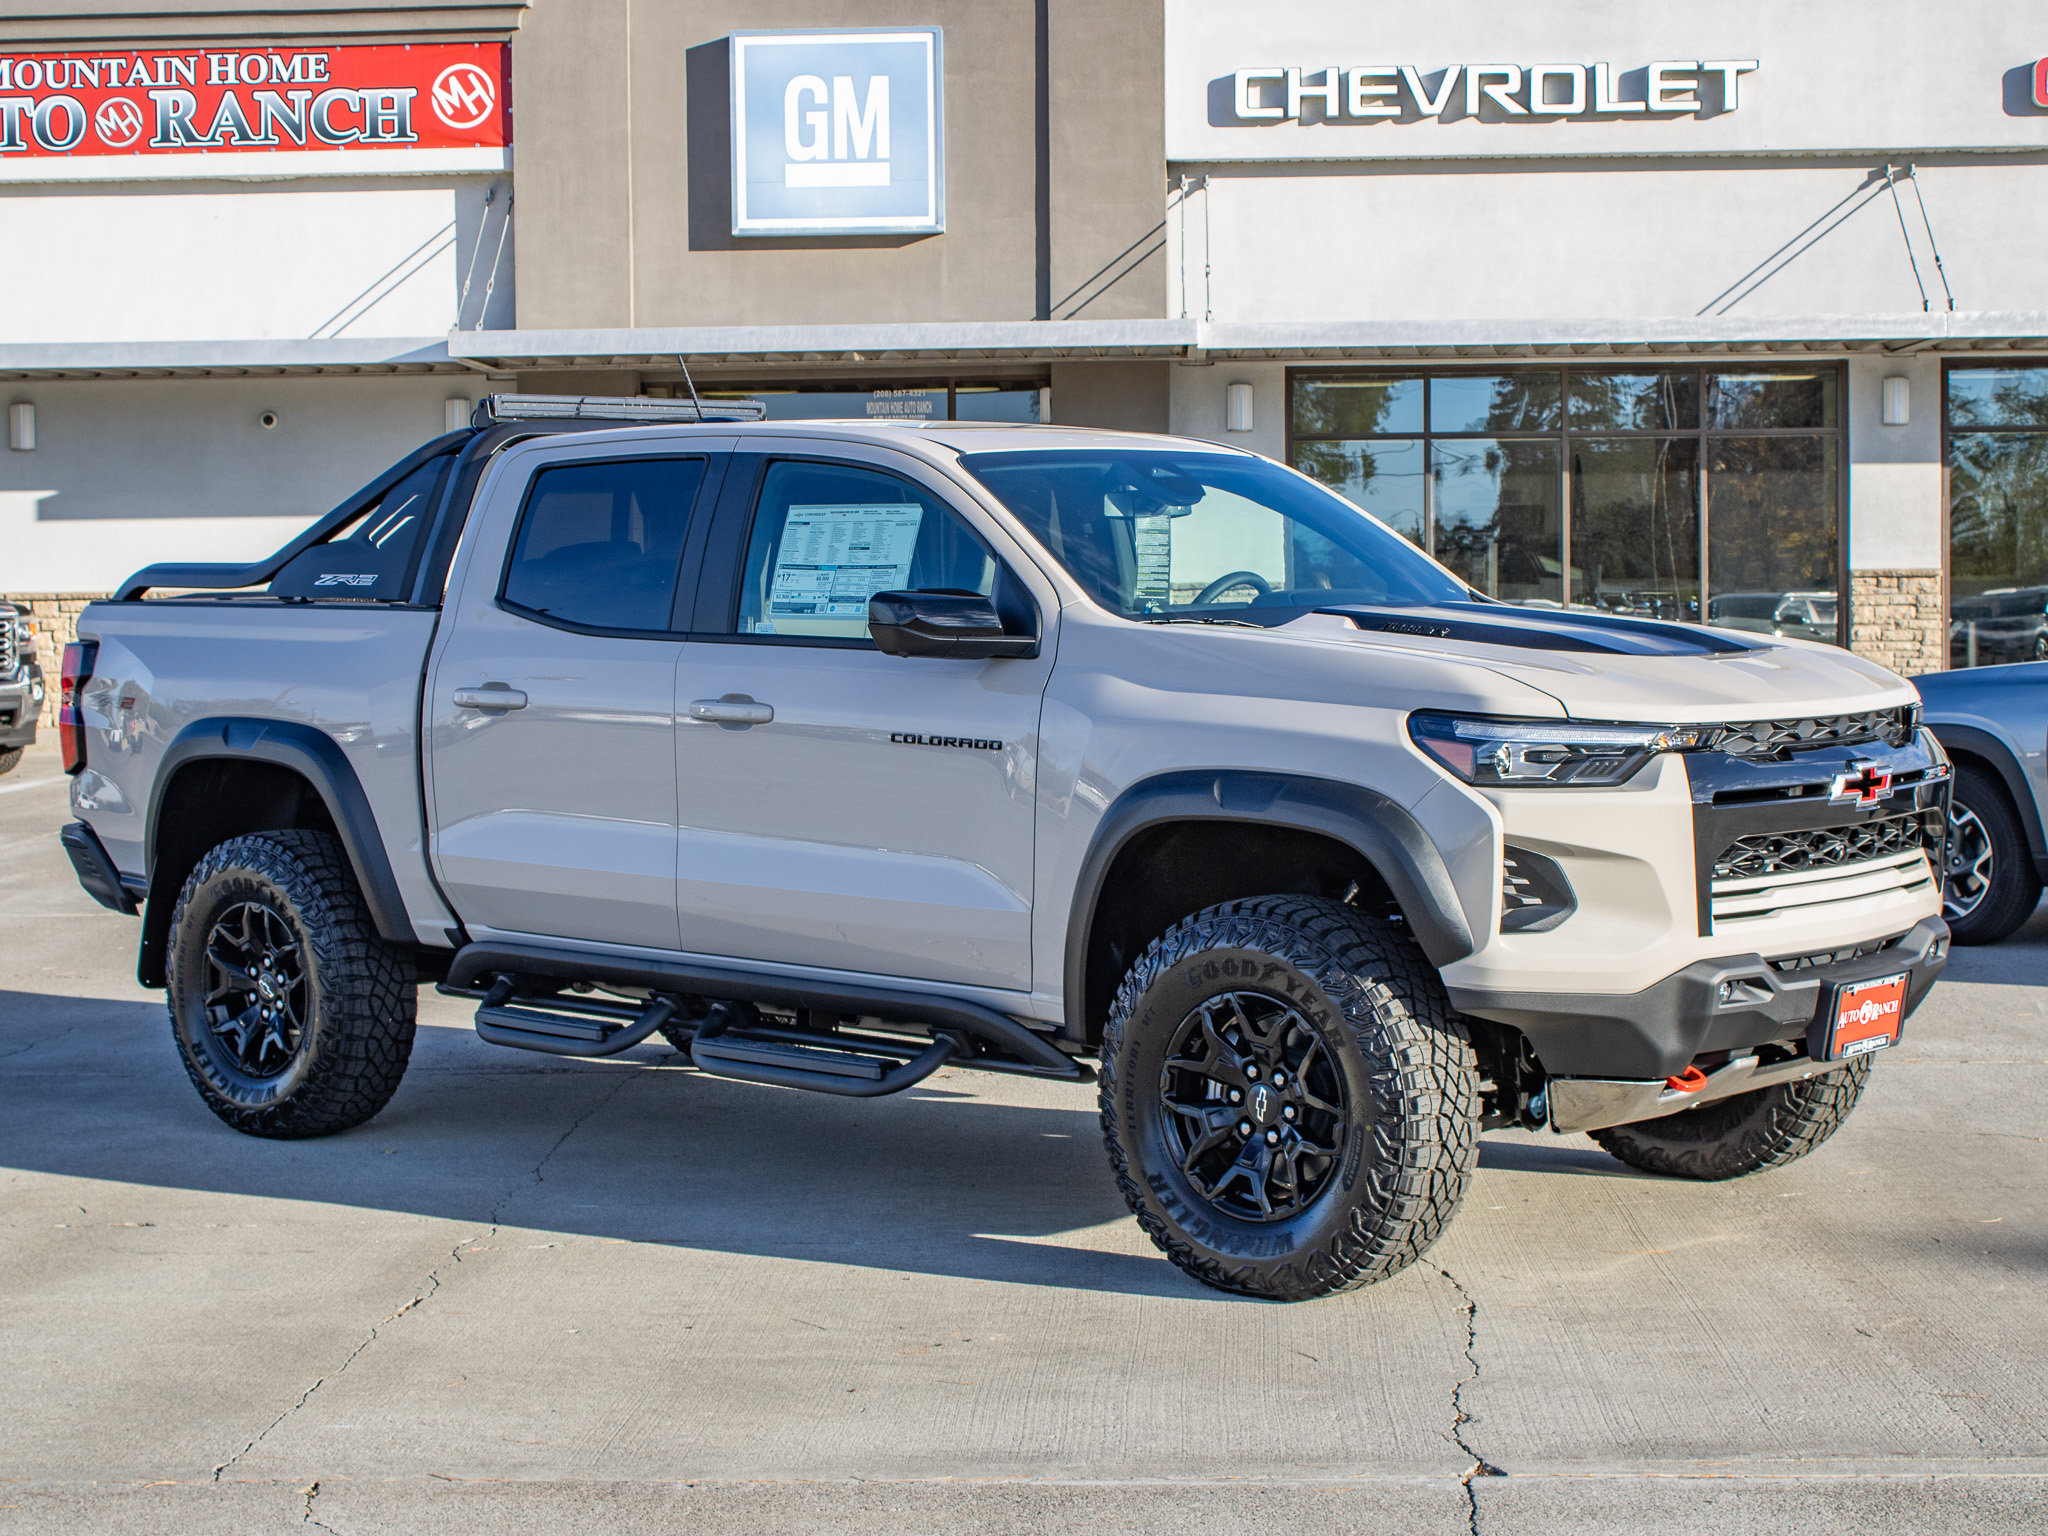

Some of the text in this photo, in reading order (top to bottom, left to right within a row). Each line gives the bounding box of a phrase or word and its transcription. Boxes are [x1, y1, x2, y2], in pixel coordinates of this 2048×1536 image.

[205, 52, 330, 85] HOME
[1233, 59, 1760, 118] CHEVROLET
[148, 86, 419, 148] RANCH
[784, 75, 891, 161] GM
[866, 400, 933, 415] MOUNTAIN HOME AUTO RANCH
[873, 390, 892, 399] (208)
[314, 574, 378, 586] ZR2
[781, 573, 791, 582] 17
[890, 733, 1003, 751] COLORADO
[1185, 957, 1347, 1048] GOODYEAR
[1836, 1000, 1899, 1030] AUTO RANCH
[1146, 1173, 1295, 1258] WRANGLER
